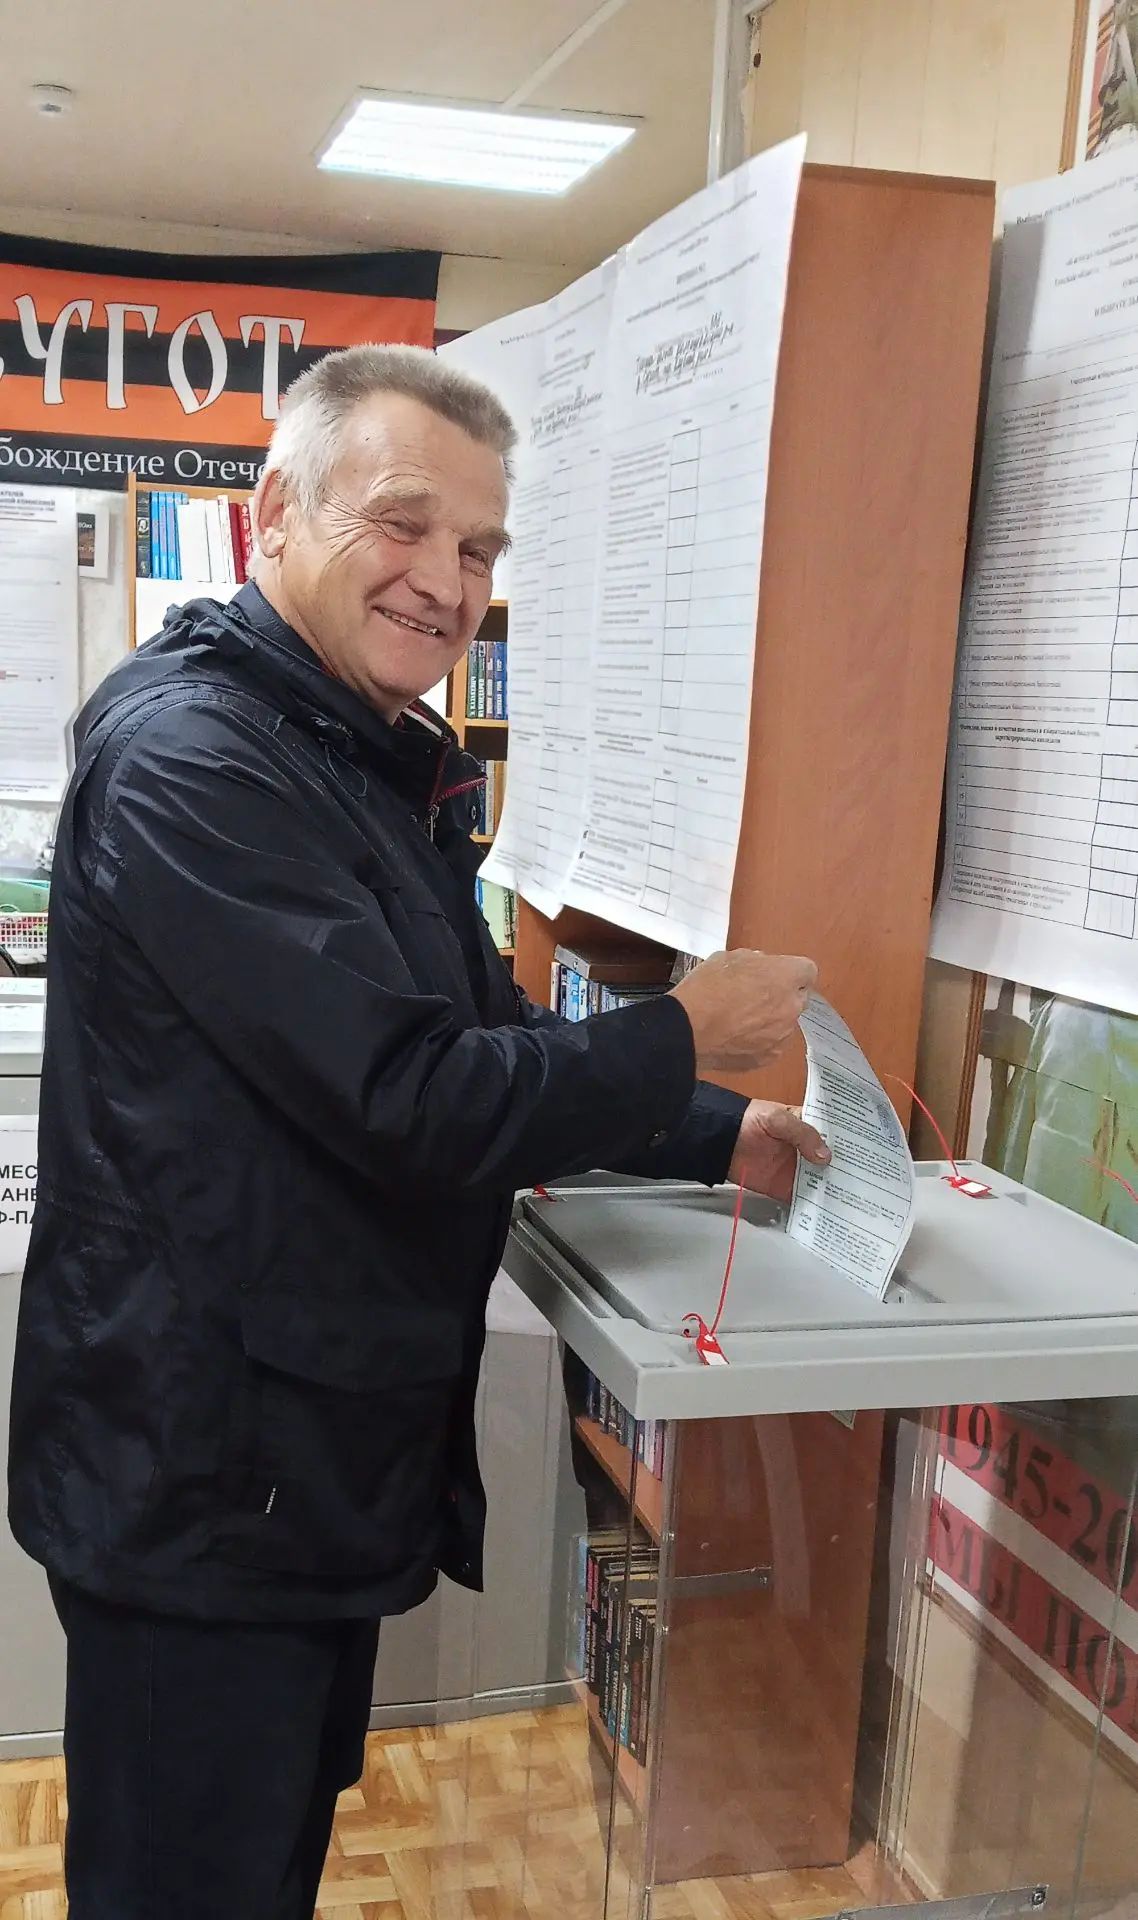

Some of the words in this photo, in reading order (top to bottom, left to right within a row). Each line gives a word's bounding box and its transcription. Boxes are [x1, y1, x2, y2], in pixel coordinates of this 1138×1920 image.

[0, 293, 306, 420] УГОТ
[0, 436, 165, 476] бождение
[1044, 1591, 1138, 1736] ПО
